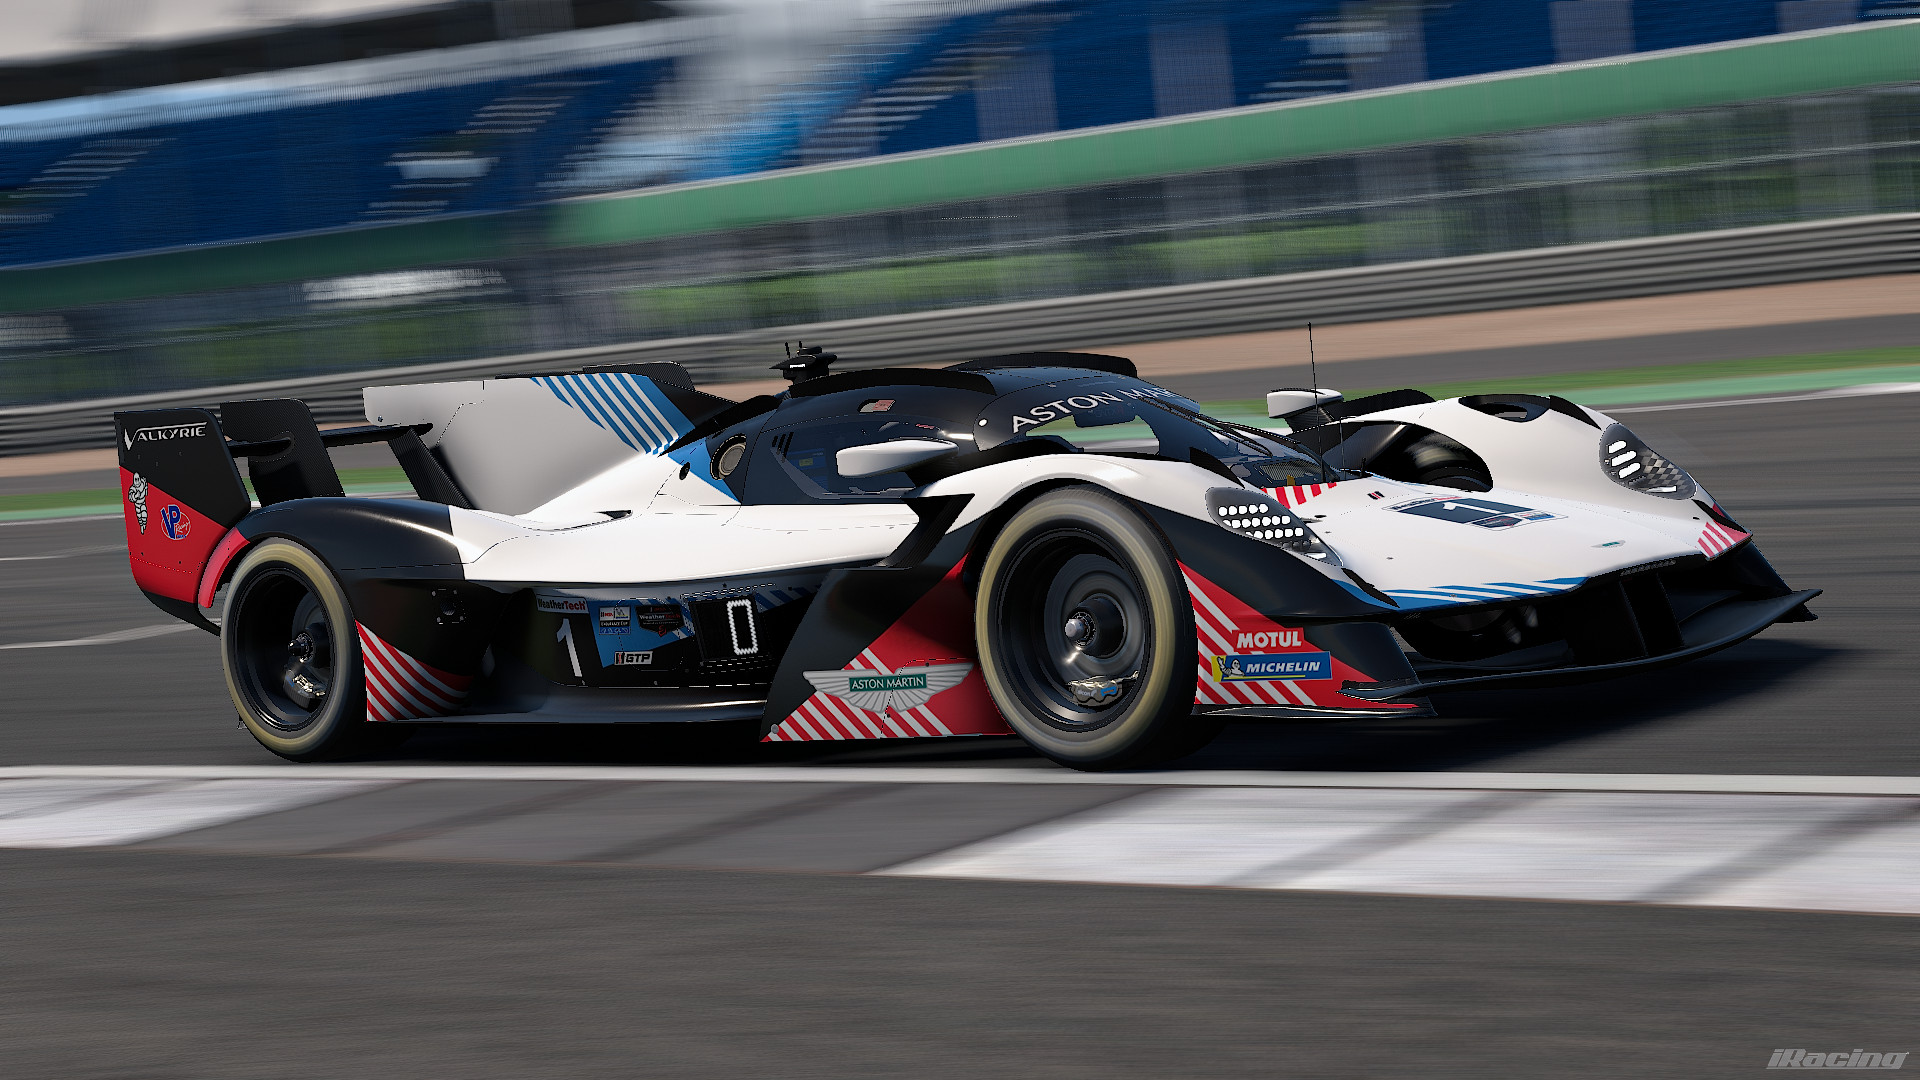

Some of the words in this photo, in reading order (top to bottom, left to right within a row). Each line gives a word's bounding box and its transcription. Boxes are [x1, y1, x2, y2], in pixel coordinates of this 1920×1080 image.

[1012, 391, 1124, 434] ASTON
[124, 421, 208, 451] VALKYRIE
[160, 504, 181, 540] VP
[537, 598, 586, 611] WeatherTech
[556, 618, 583, 678] 1
[1236, 631, 1302, 649] MOTUL
[626, 653, 651, 663] GTP
[1246, 661, 1321, 674] MICHELIN
[852, 679, 884, 690] ASTON
[886, 677, 924, 688] MARTIN
